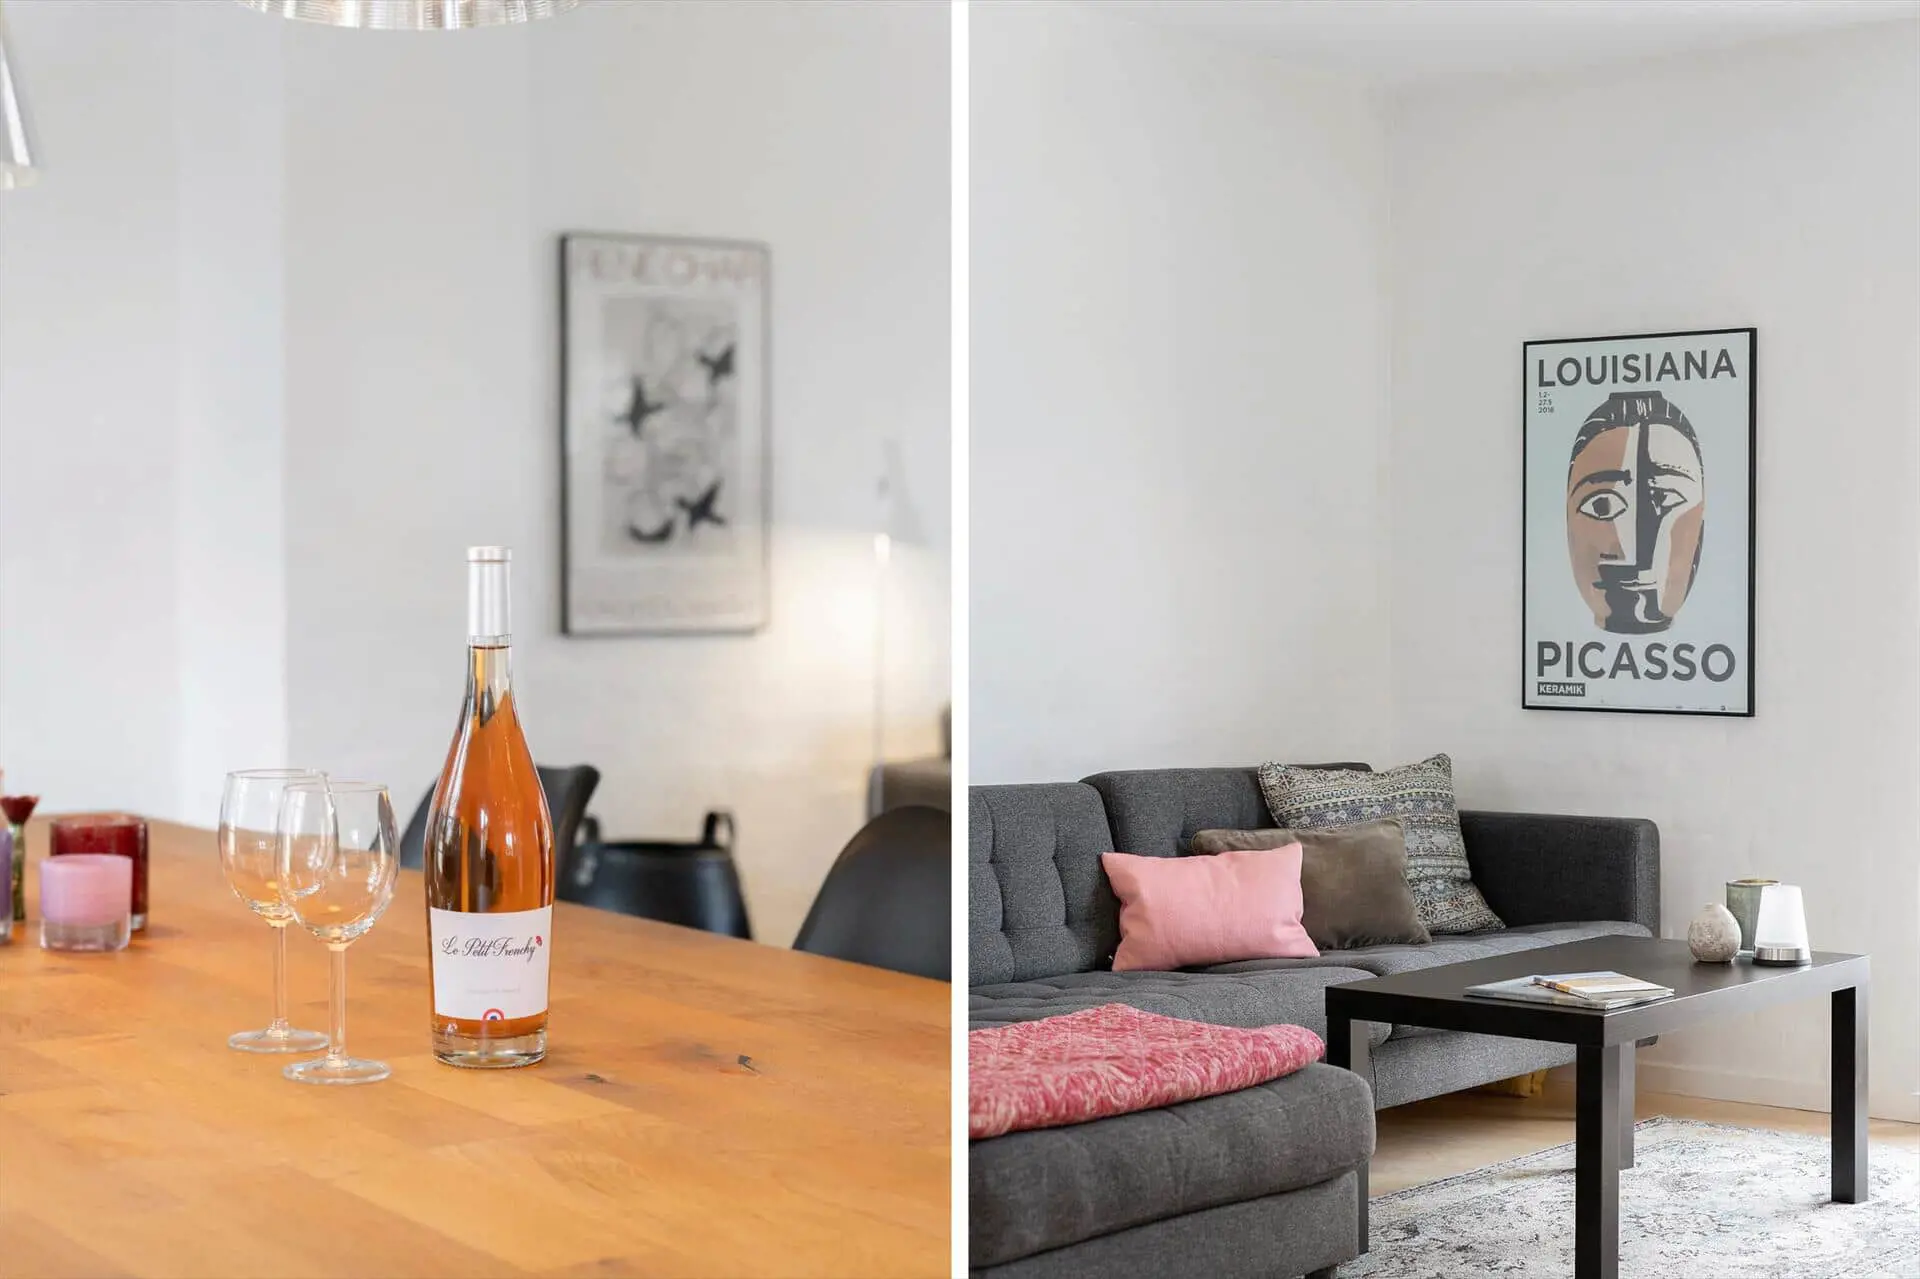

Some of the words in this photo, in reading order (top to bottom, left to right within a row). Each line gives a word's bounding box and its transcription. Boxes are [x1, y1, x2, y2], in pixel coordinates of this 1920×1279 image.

[1538, 348, 1737, 387] LOUISIANA
[1537, 641, 1736, 682] PICASSO
[1539, 684, 1583, 695] KERAMIK
[442, 936, 458, 954] Le
[462, 938, 494, 956] Petit
[493, 937, 535, 963] Frenchy
